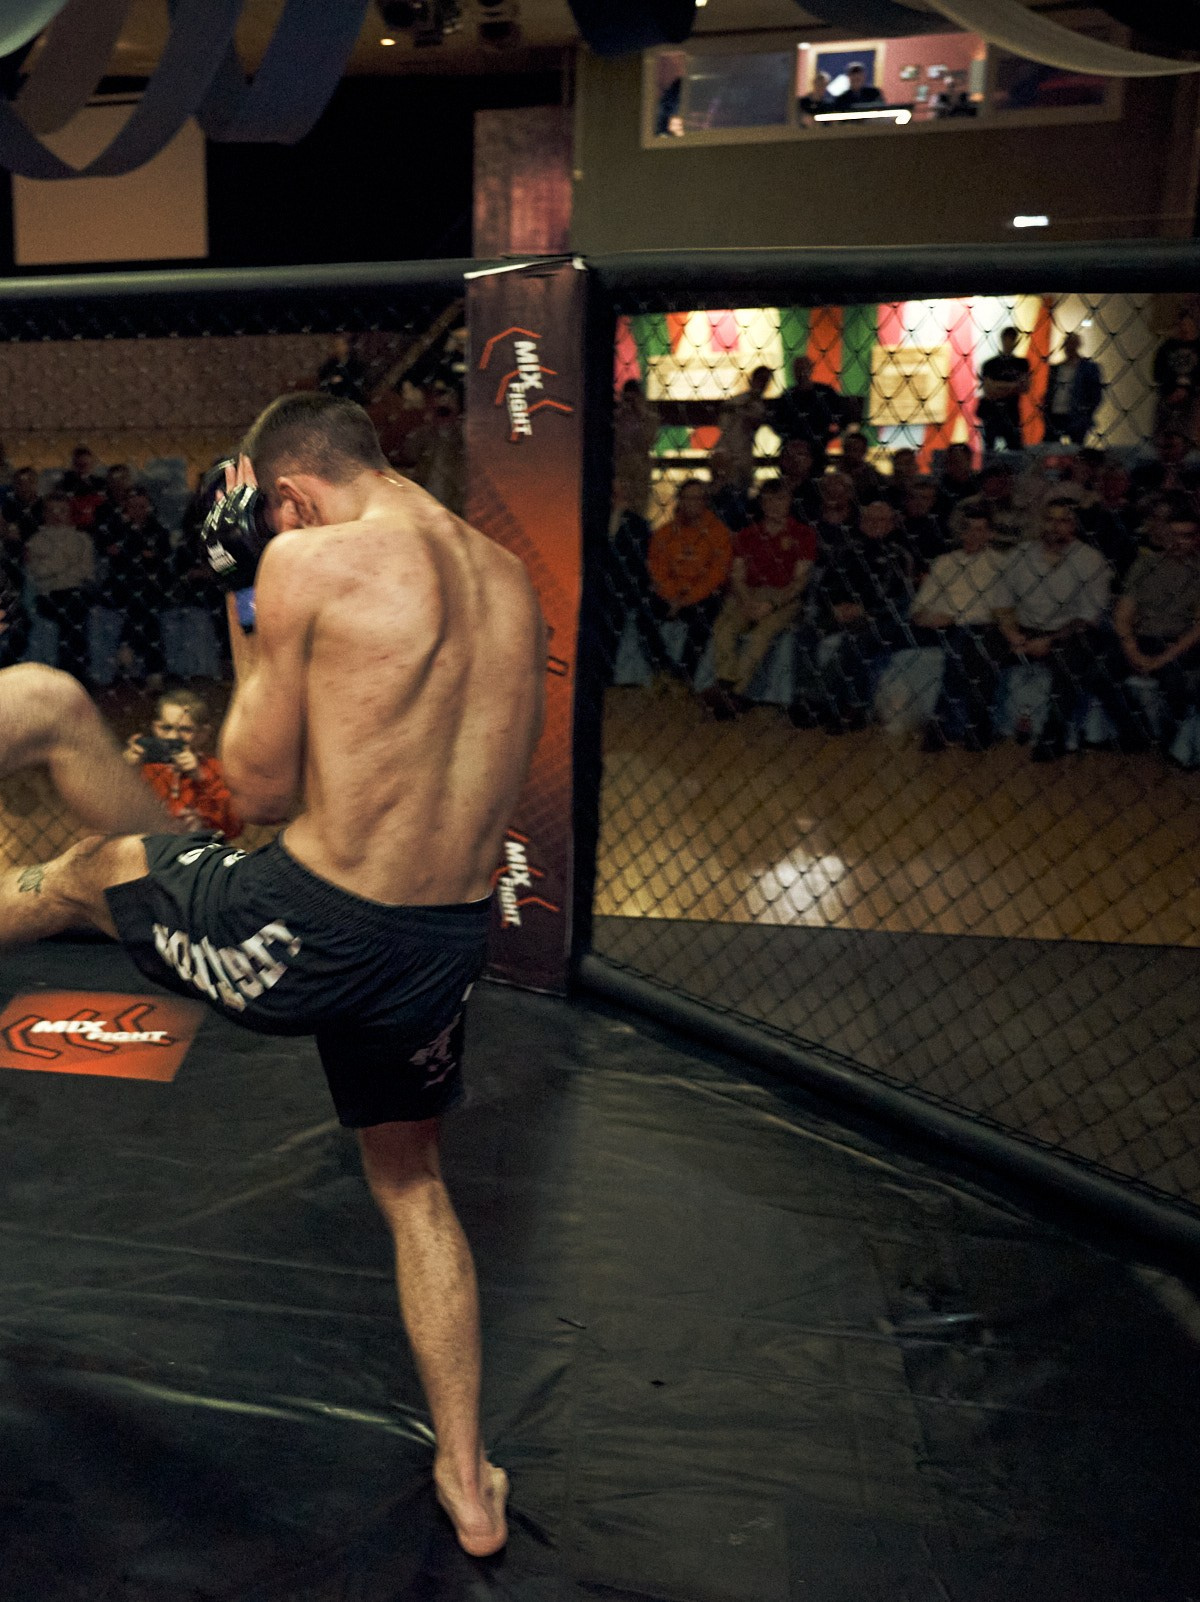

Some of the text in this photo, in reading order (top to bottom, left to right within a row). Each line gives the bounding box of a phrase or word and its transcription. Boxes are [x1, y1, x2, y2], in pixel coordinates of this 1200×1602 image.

[507, 340, 544, 435] MIX FIGHT
[504, 841, 532, 887] MIX
[31, 1020, 107, 1033] MIX
